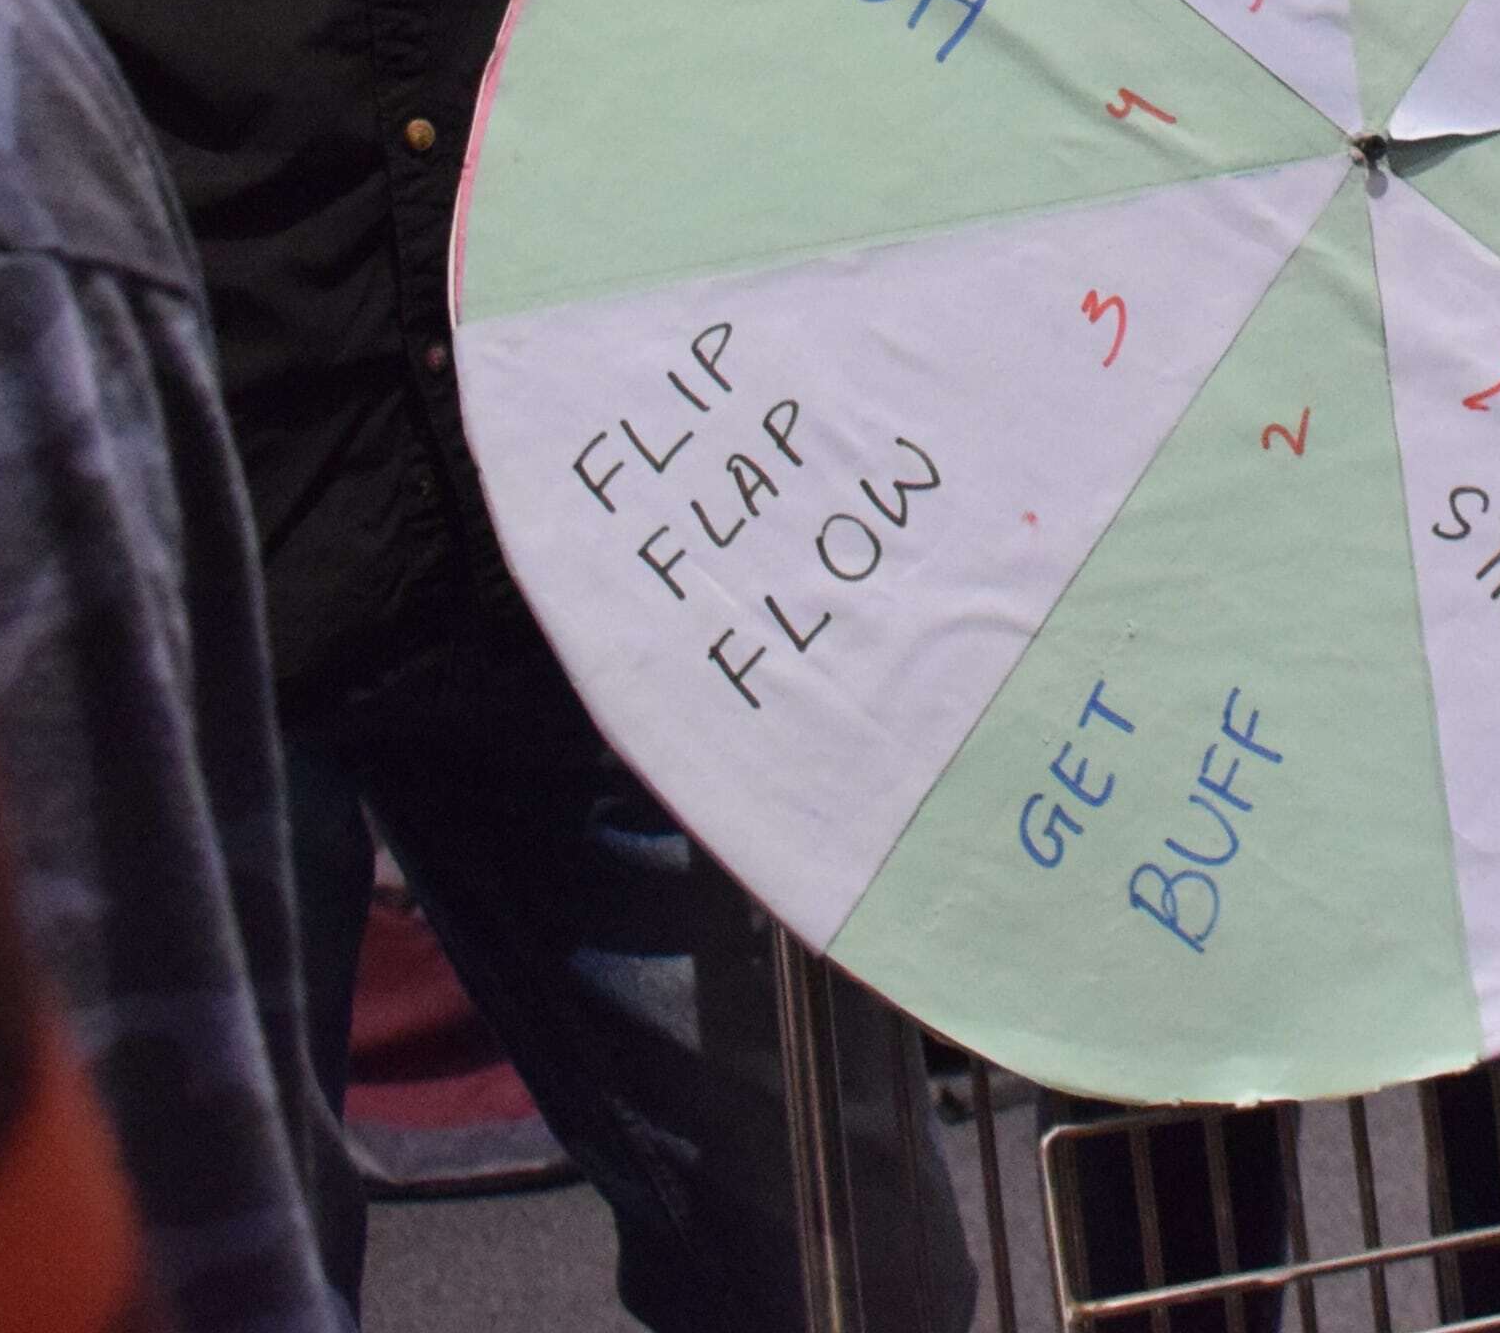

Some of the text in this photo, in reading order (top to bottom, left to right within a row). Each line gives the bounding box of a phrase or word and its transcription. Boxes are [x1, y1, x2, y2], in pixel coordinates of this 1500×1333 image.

[1106, 88, 1176, 124] 4
[572, 322, 732, 514] FLIP
[1081, 290, 1126, 367] 3
[637, 399, 803, 601] FLAP
[1261, 407, 1310, 456] 2
[708, 437, 941, 709] FLOW
[1020, 680, 1135, 868] GET
[1129, 687, 1283, 953] BUFF
